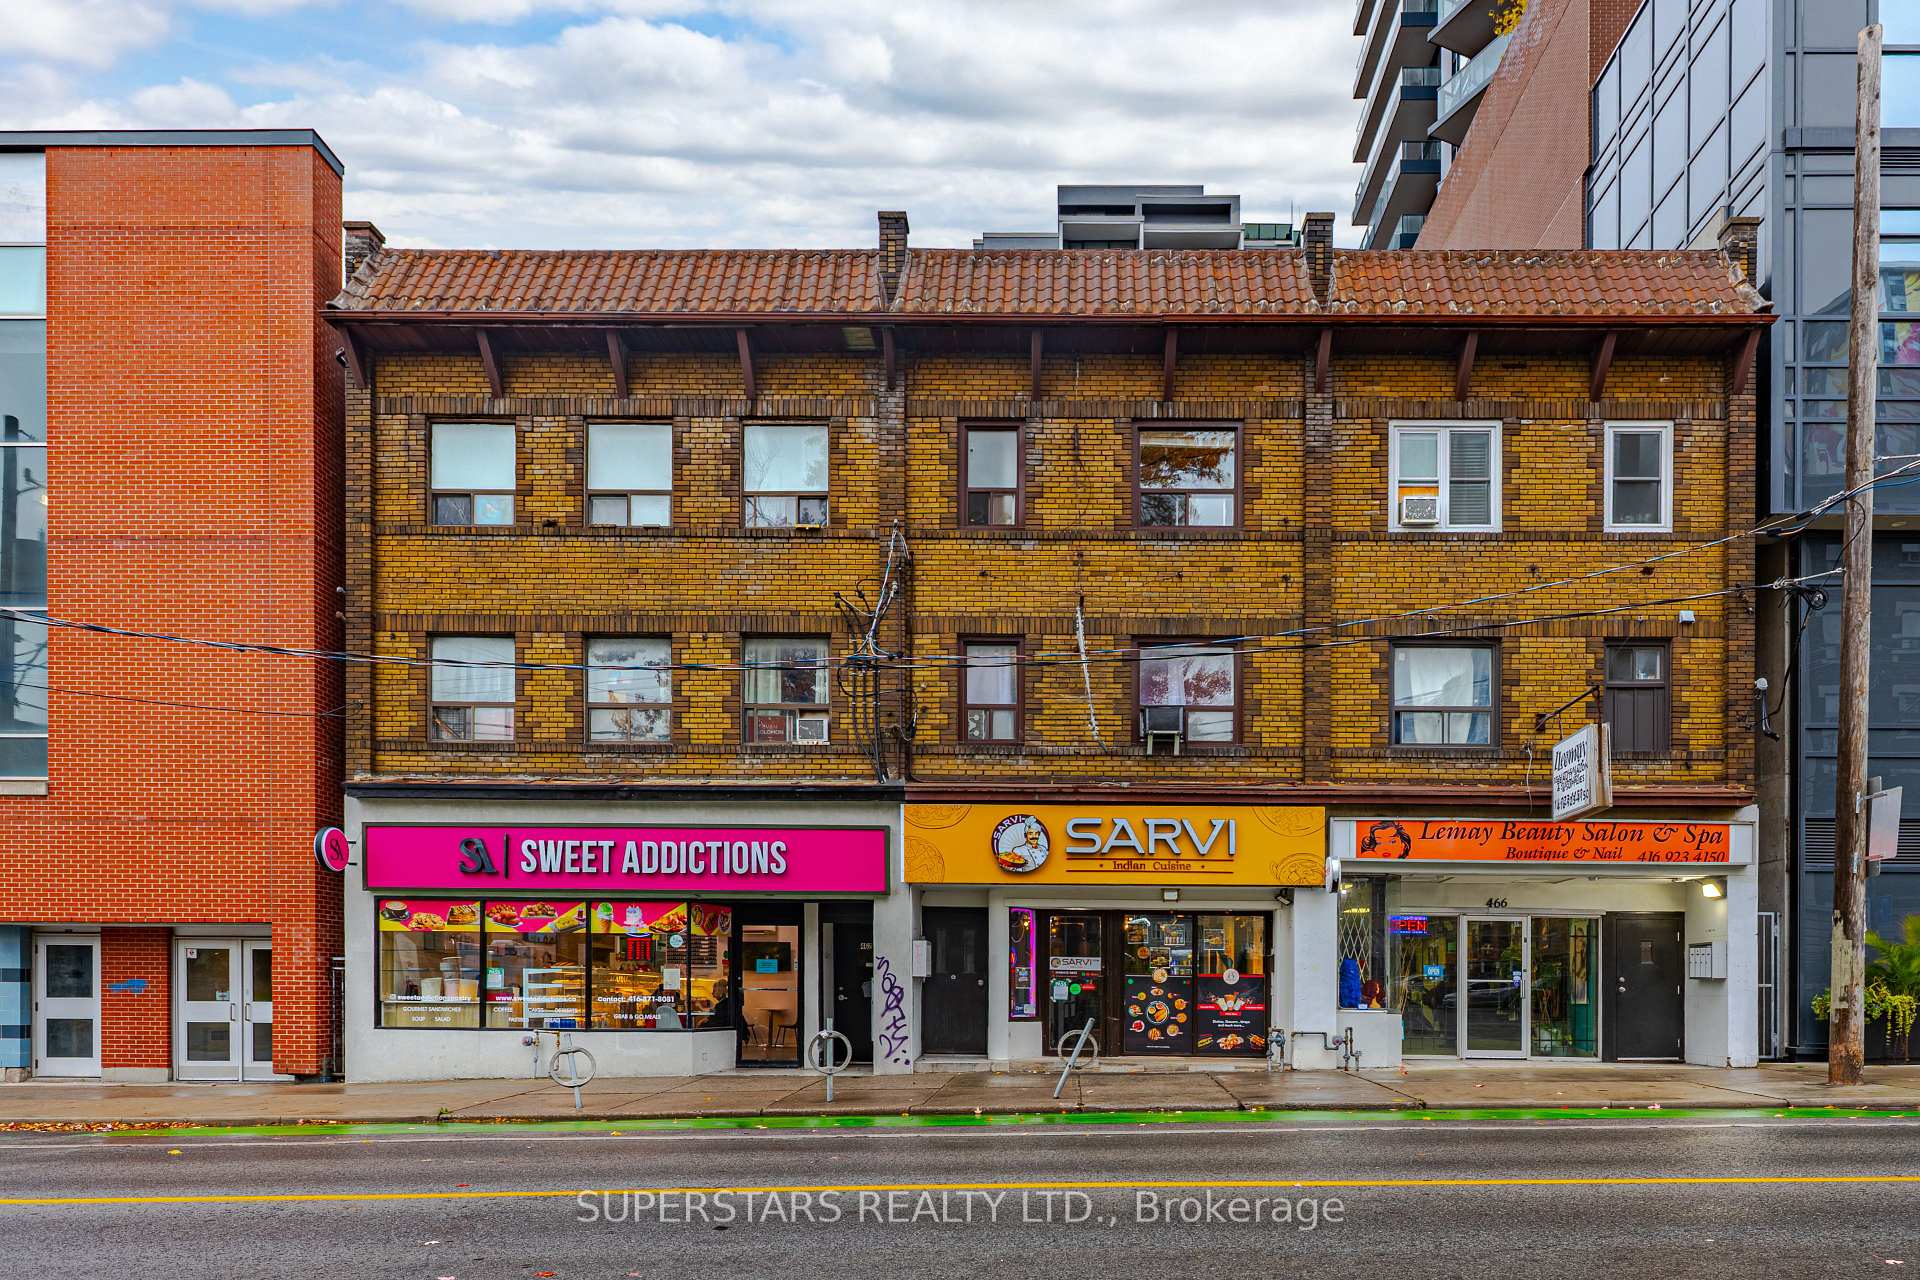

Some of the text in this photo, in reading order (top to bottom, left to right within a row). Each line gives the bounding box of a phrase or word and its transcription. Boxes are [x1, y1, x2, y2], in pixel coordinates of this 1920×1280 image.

[1066, 817, 1236, 856] SARVI
[1418, 820, 1723, 851] Lemay Beauty Salon & Spa
[520, 839, 787, 875] SWEET ADDICTIONS
[1505, 846, 1623, 861] Boutique & Nail
[1637, 850, 1726, 863] 416 923 4150
[1112, 860, 1192, 872] Indian Cuisine
[1486, 898, 1508, 908] 466
